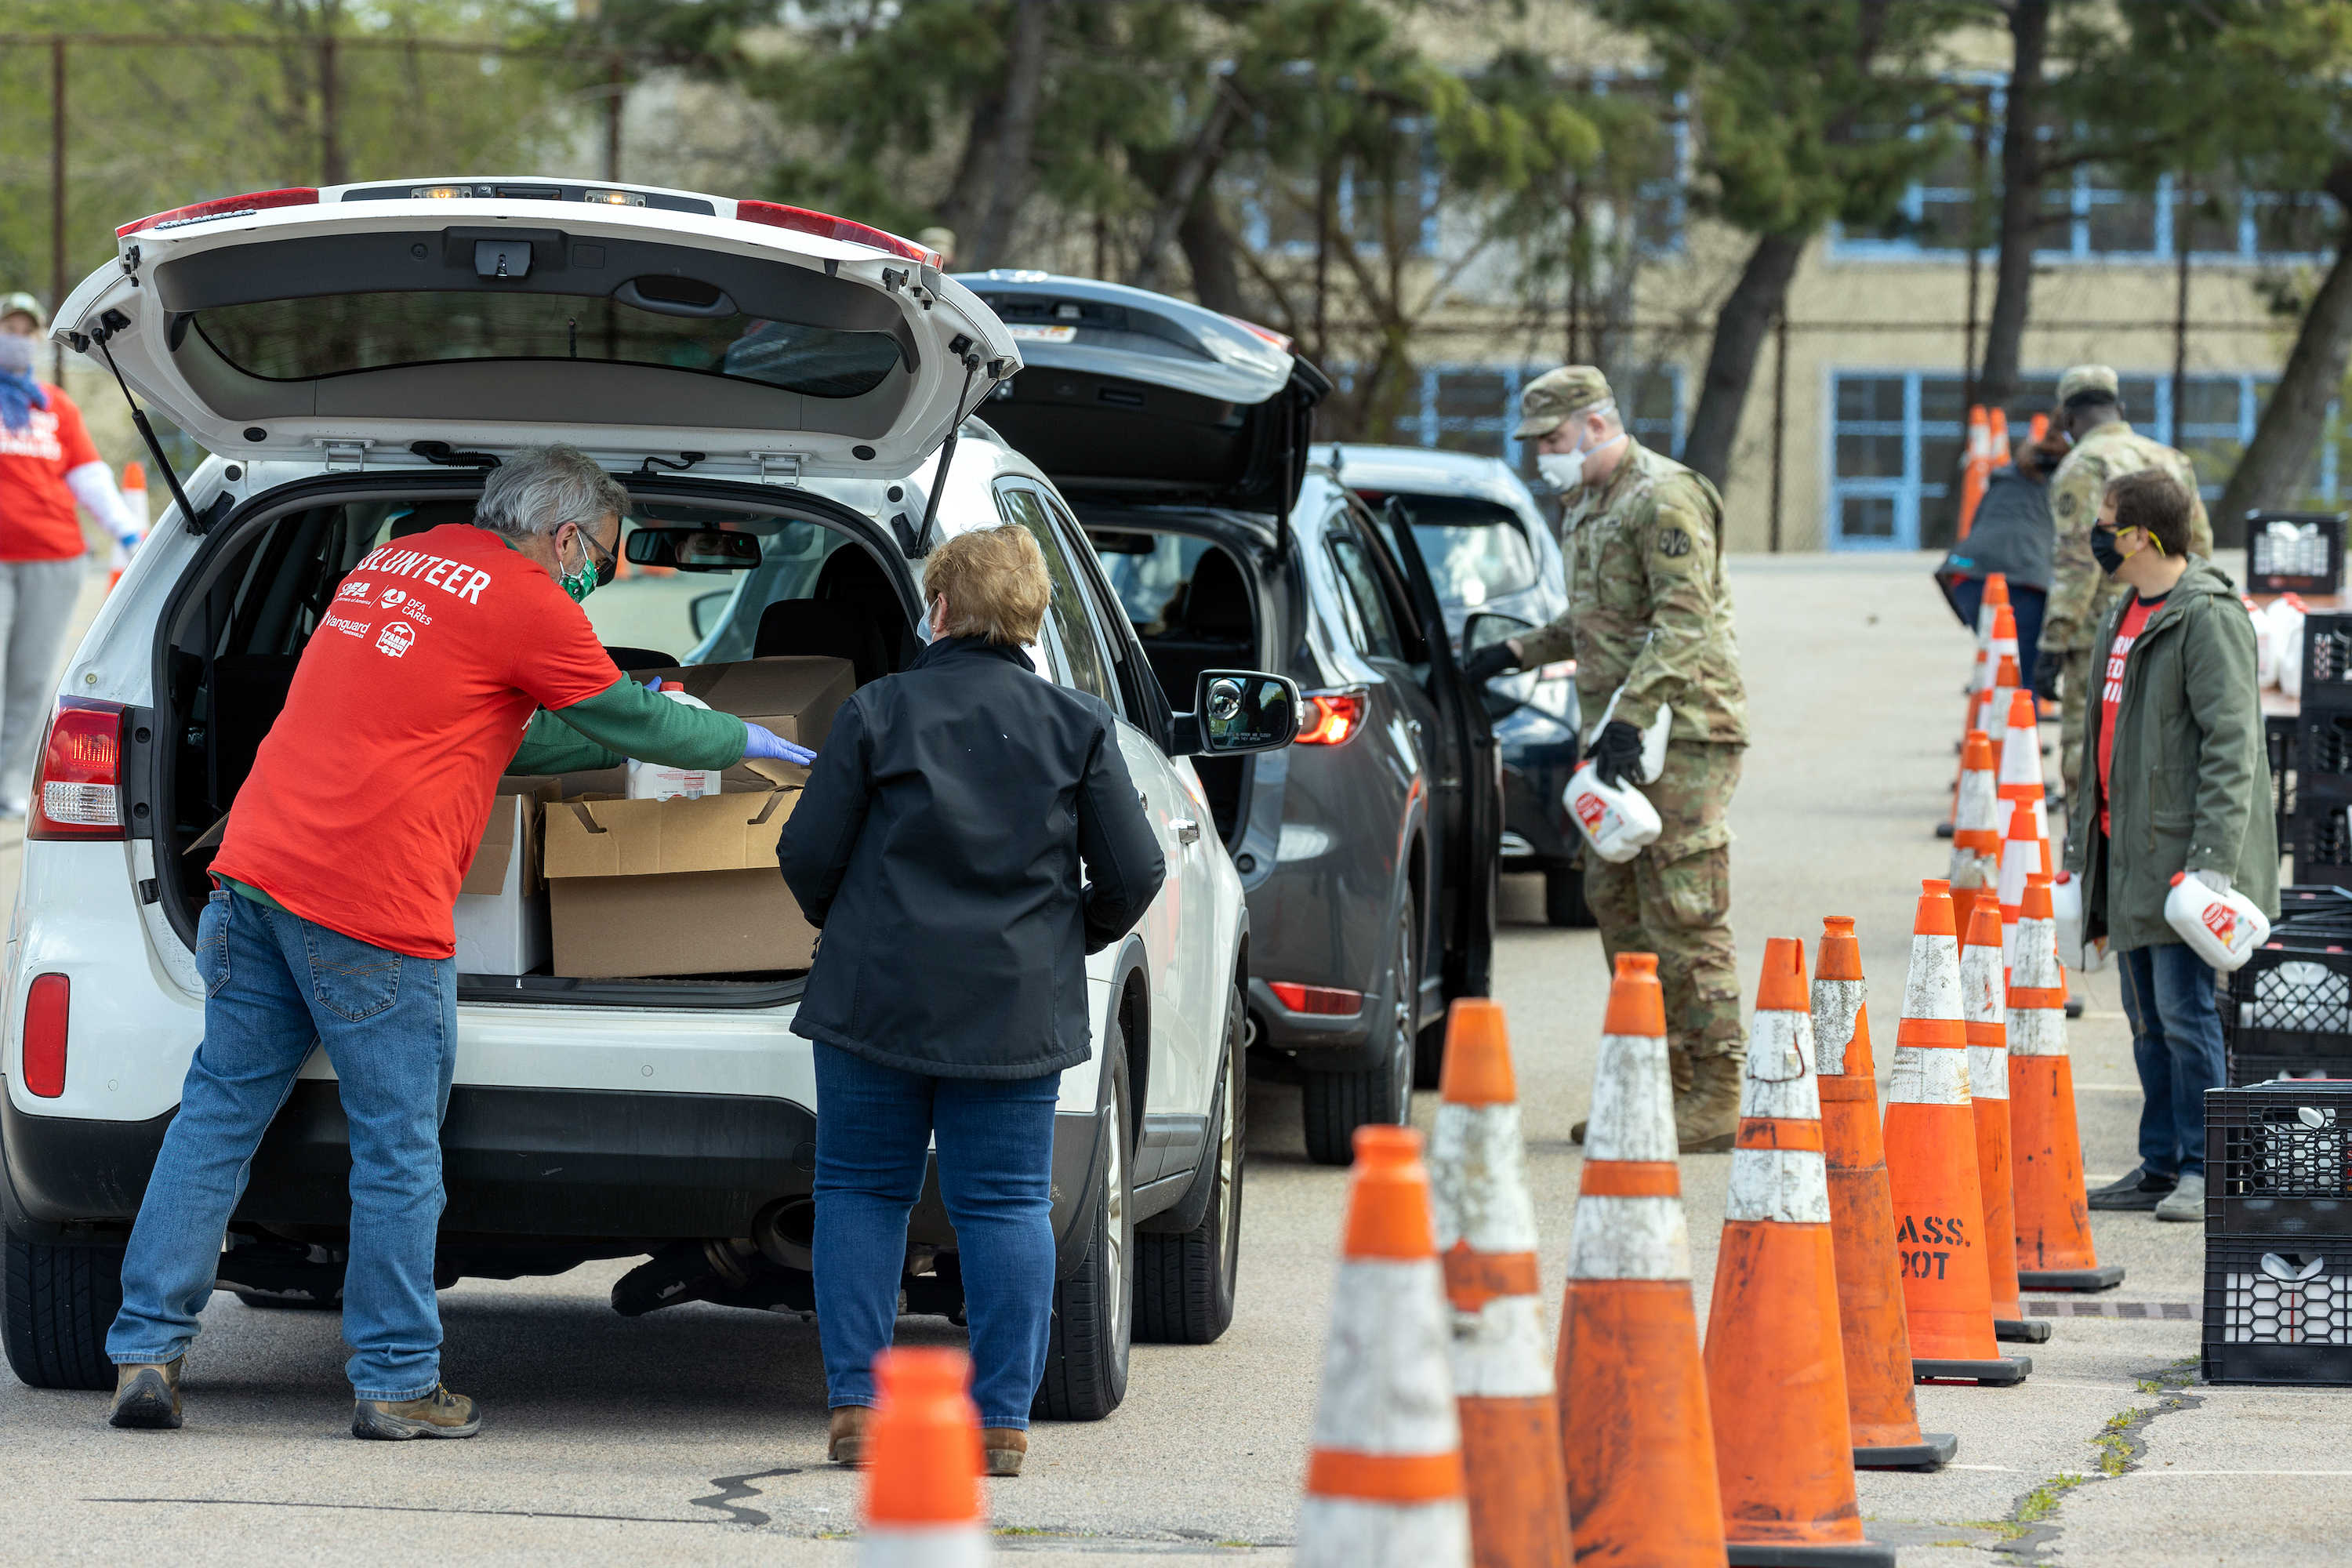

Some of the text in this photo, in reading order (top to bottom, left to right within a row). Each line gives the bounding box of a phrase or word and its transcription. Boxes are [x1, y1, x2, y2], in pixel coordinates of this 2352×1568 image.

[349, 547, 492, 605] OLUNTEER
[407, 598, 426, 612] DFA
[325, 615, 372, 634] Vanguard
[401, 606, 433, 626] CARES
[384, 630, 408, 647] FARM
[2211, 910, 2232, 932] MILK
[1893, 1215, 1971, 1247] ASS.
